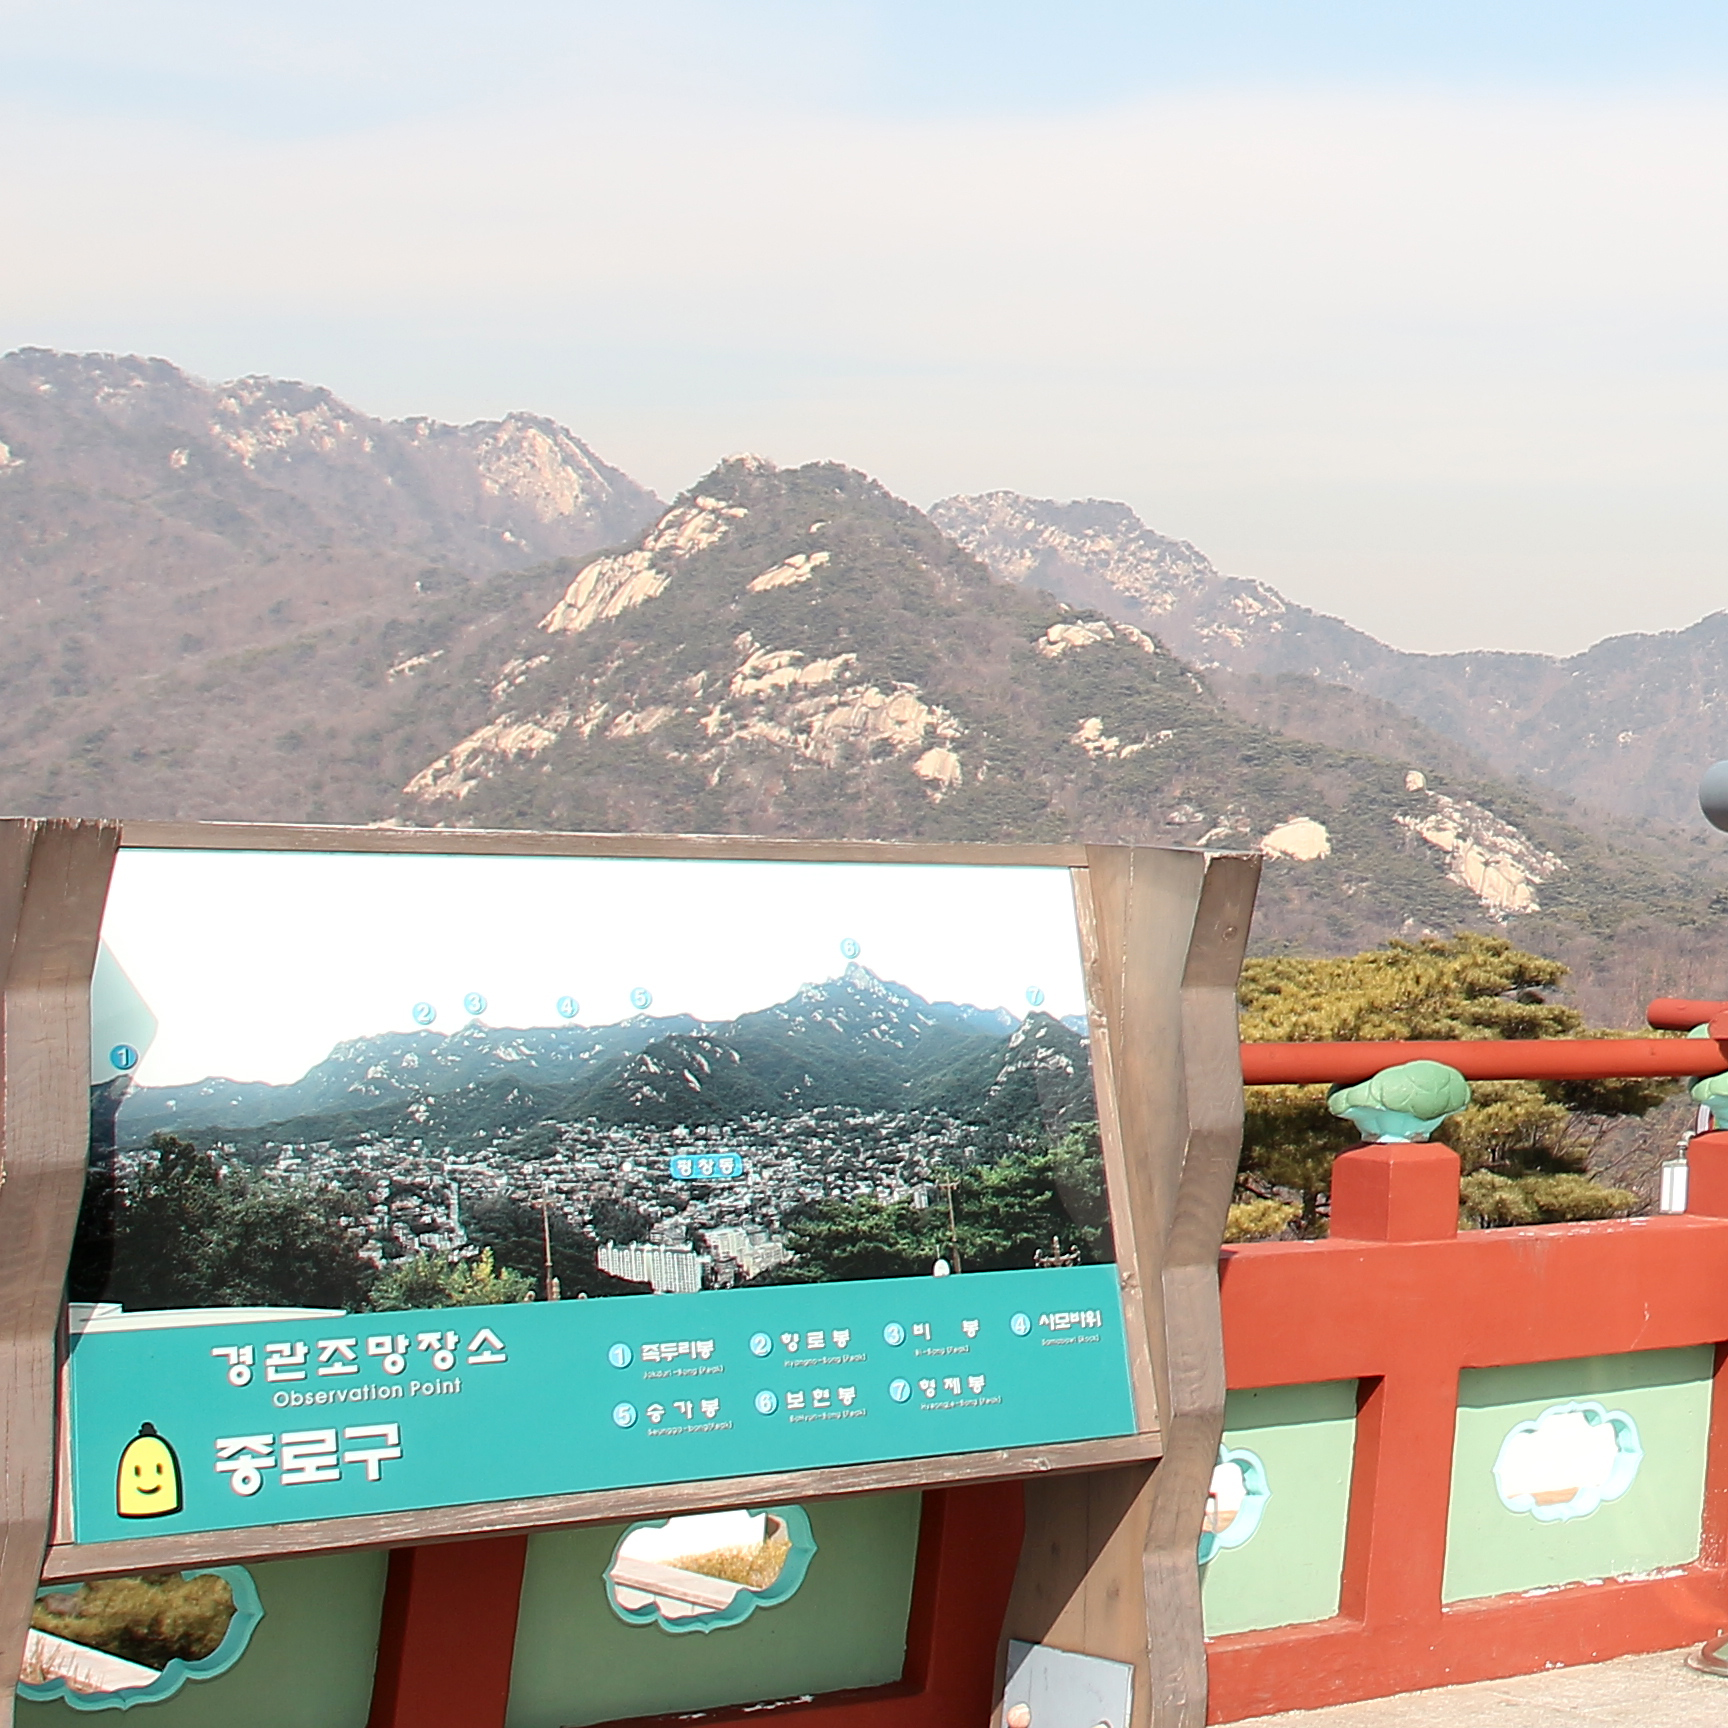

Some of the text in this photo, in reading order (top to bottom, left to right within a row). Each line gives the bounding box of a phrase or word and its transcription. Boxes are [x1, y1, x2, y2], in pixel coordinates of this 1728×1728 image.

[1039, 1310, 1102, 1331] 사모바위
[210, 1327, 508, 1387] 경관조망장소
[641, 1339, 715, 1362] 족두리봉
[272, 1377, 463, 1409] Observation Point
[214, 1422, 403, 1497] 종로구
